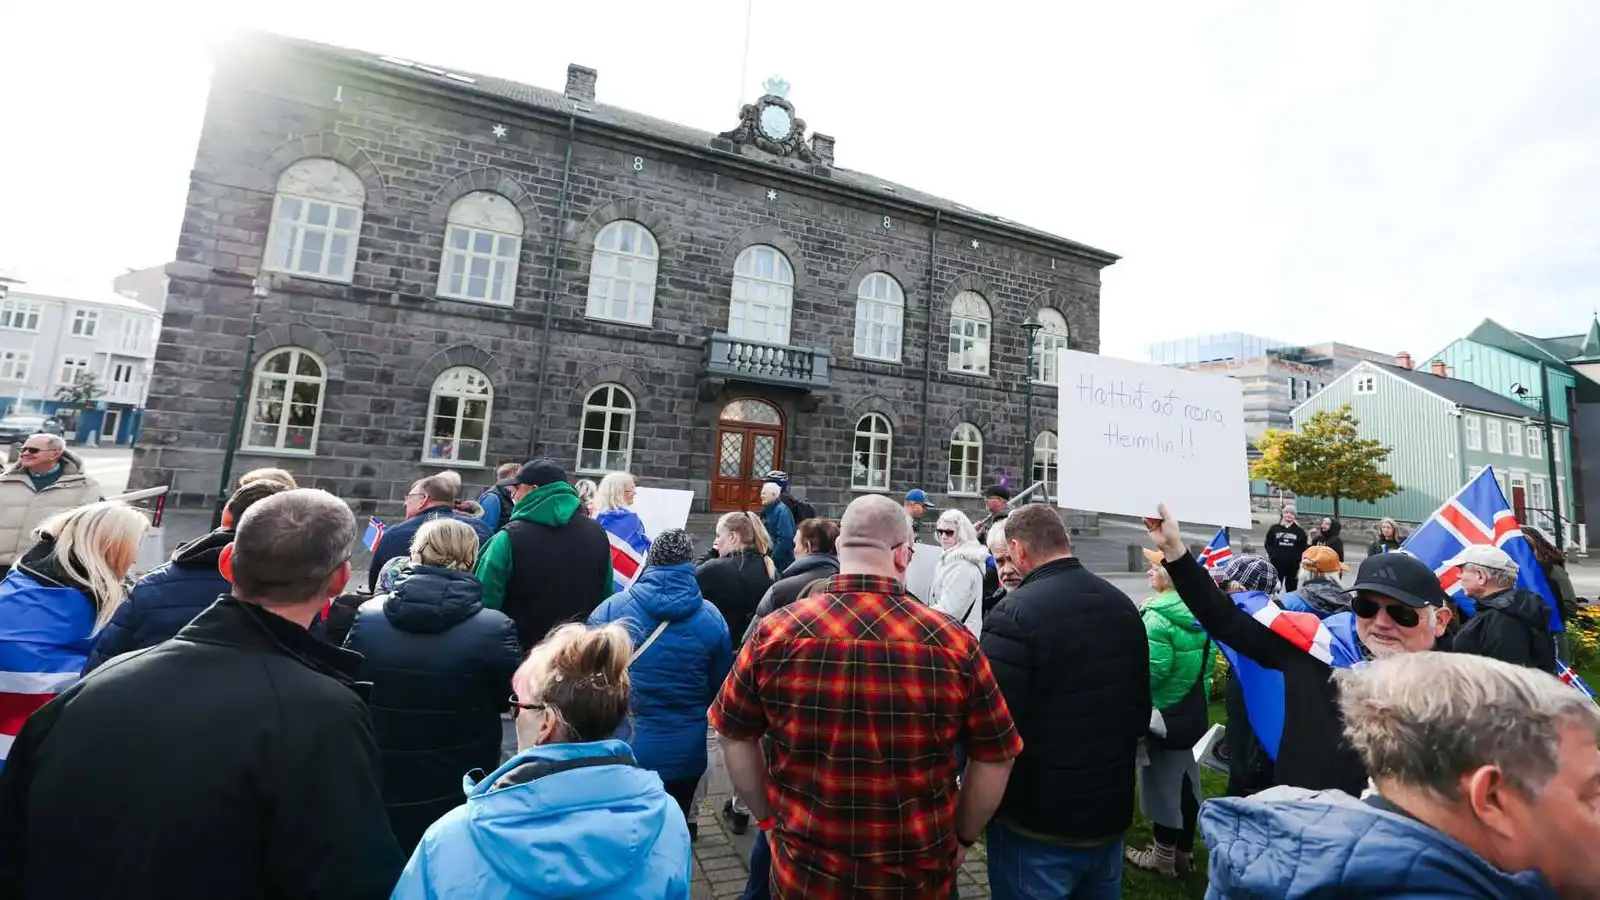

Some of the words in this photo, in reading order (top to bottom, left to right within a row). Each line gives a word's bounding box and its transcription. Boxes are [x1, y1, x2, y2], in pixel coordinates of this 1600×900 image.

[333, 85, 343, 102] 1
[633, 156, 643, 170] 8
[883, 216, 891, 229] 8
